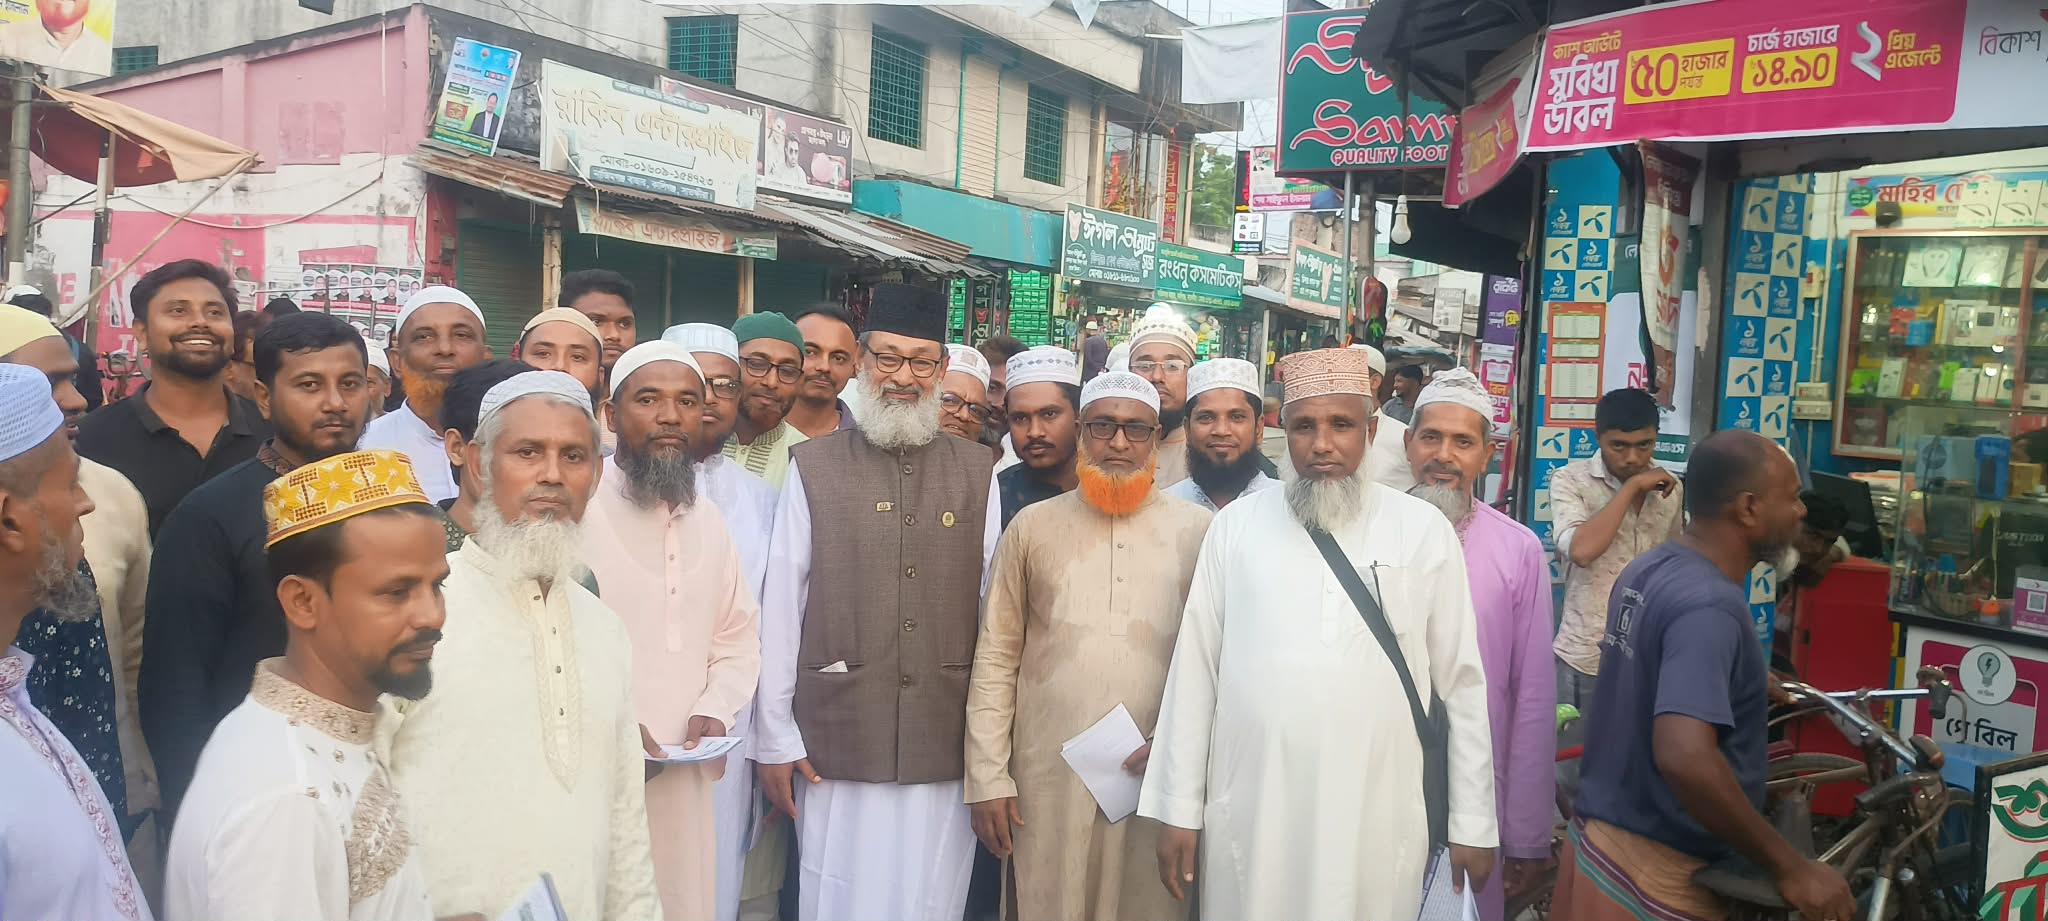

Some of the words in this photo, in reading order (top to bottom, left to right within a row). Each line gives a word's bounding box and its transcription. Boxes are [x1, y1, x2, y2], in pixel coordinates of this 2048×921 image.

[1553, 41, 1580, 60] ক্যাশ
[1583, 30, 1621, 54] আউটে
[1748, 26, 1780, 52] চার্জ
[1783, 24, 1840, 48] হাজারে
[1979, 26, 2042, 56] বিকাশ
[1680, 51, 1729, 72] হাজার
[1851, 21, 1882, 82] ২
[1548, 53, 1619, 104] সুবিধা
[1544, 97, 1616, 134] ডাবল
[1331, 147, 1398, 166] QUALITY
[1878, 177, 1937, 204] মাহির
[1785, 195, 1795, 213] ১
[1557, 208, 1568, 222] ১
[1587, 241, 1597, 255] ১
[1750, 233, 1762, 253] ১
[1159, 259, 1189, 289] রংধনু
[1554, 272, 1564, 286] ১
[1777, 280, 1788, 298] ১
[1744, 320, 1755, 338] ১
[1772, 364, 1781, 381] ১
[1739, 401, 1750, 418] ১
[1579, 430, 1588, 443] ১
[1975, 718, 2018, 751] বিল
